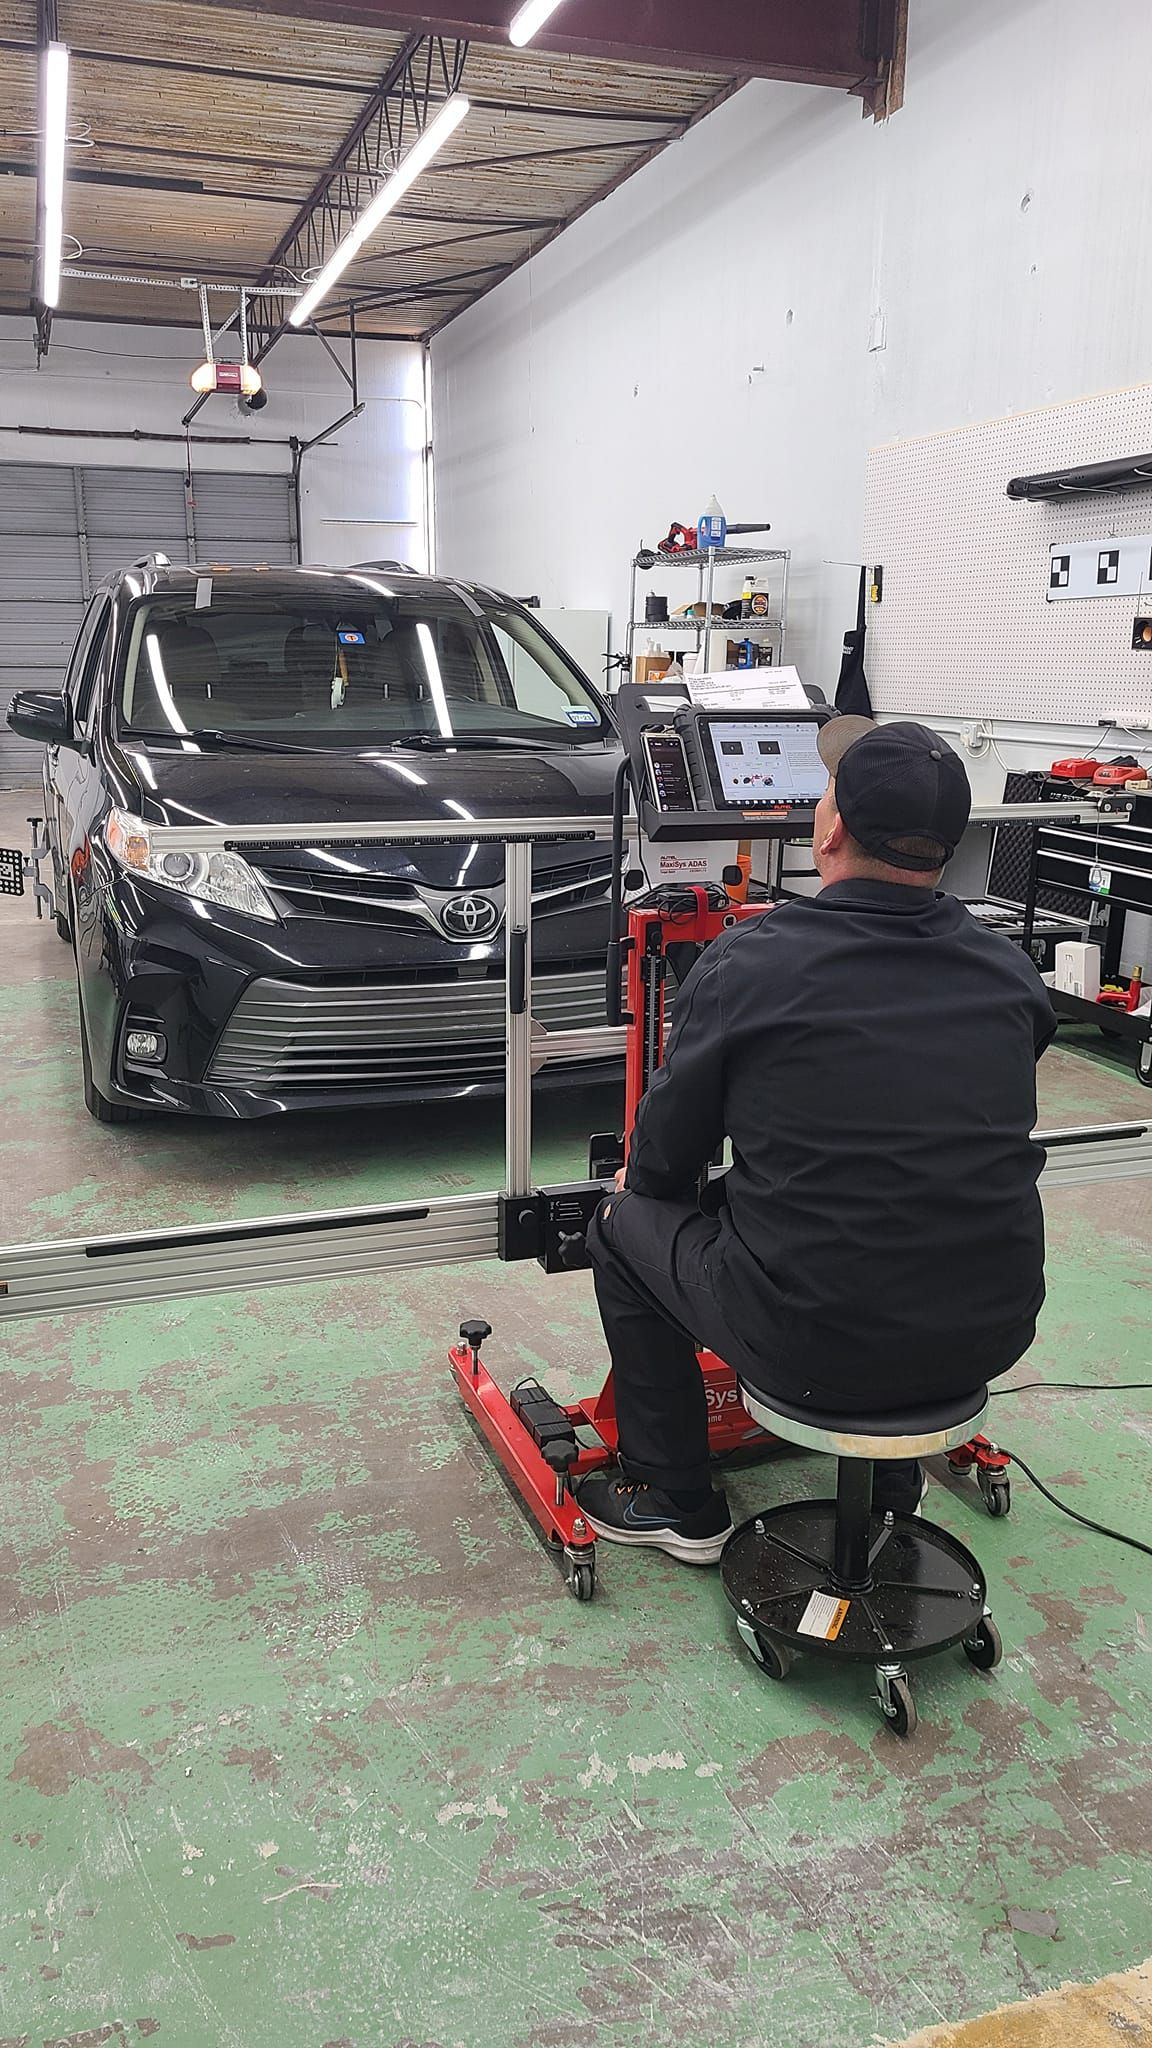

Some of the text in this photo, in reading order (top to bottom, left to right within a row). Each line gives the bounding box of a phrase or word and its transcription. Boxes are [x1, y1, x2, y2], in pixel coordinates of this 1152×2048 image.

[660, 860, 708, 869] MaxiSys ADAS
[705, 1389, 737, 1408] Sys
